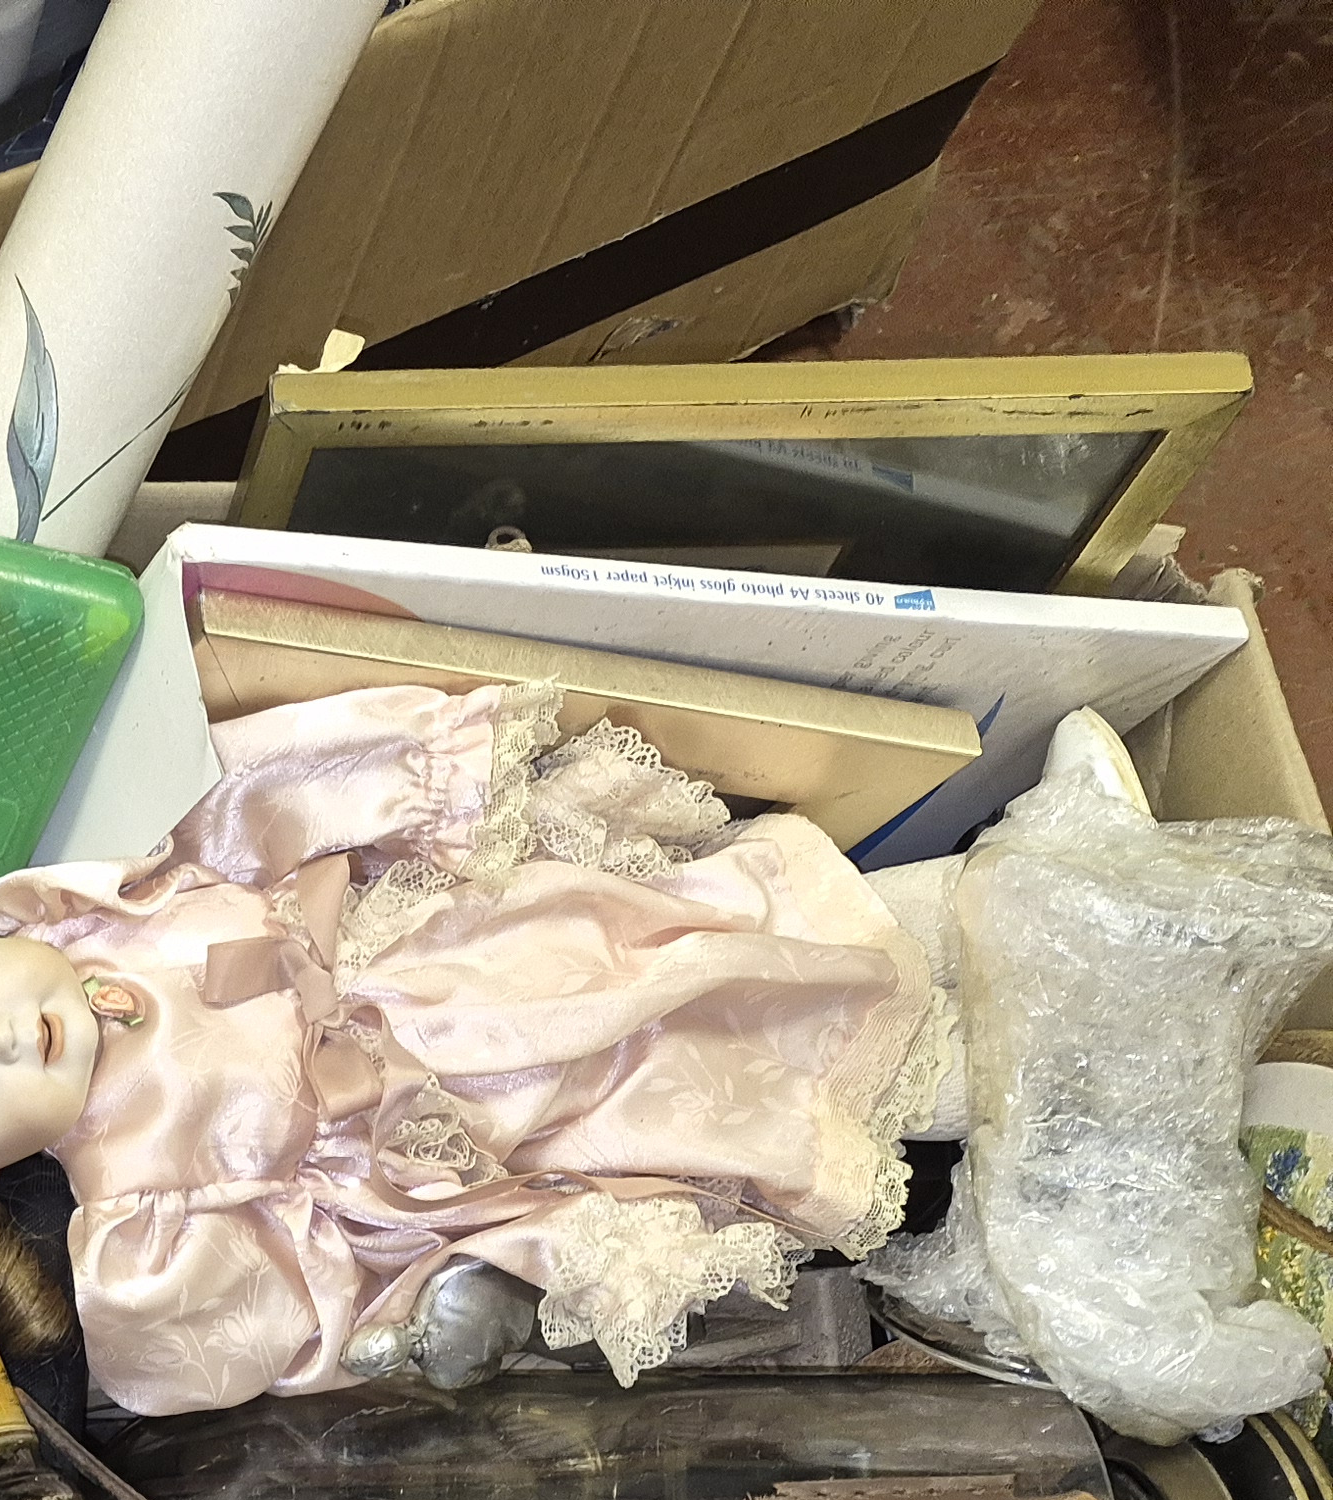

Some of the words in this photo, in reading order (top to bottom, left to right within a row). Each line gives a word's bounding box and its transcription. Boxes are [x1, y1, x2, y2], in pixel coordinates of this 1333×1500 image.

[539, 564, 599, 586] 150gsm
[606, 572, 649, 590] paper
[654, 575, 696, 592] inkjet
[699, 579, 737, 594] gloss
[740, 582, 784, 597] photo
[787, 586, 810, 599] A4
[814, 589, 861, 603] sheets
[866, 593, 884, 606] 40
